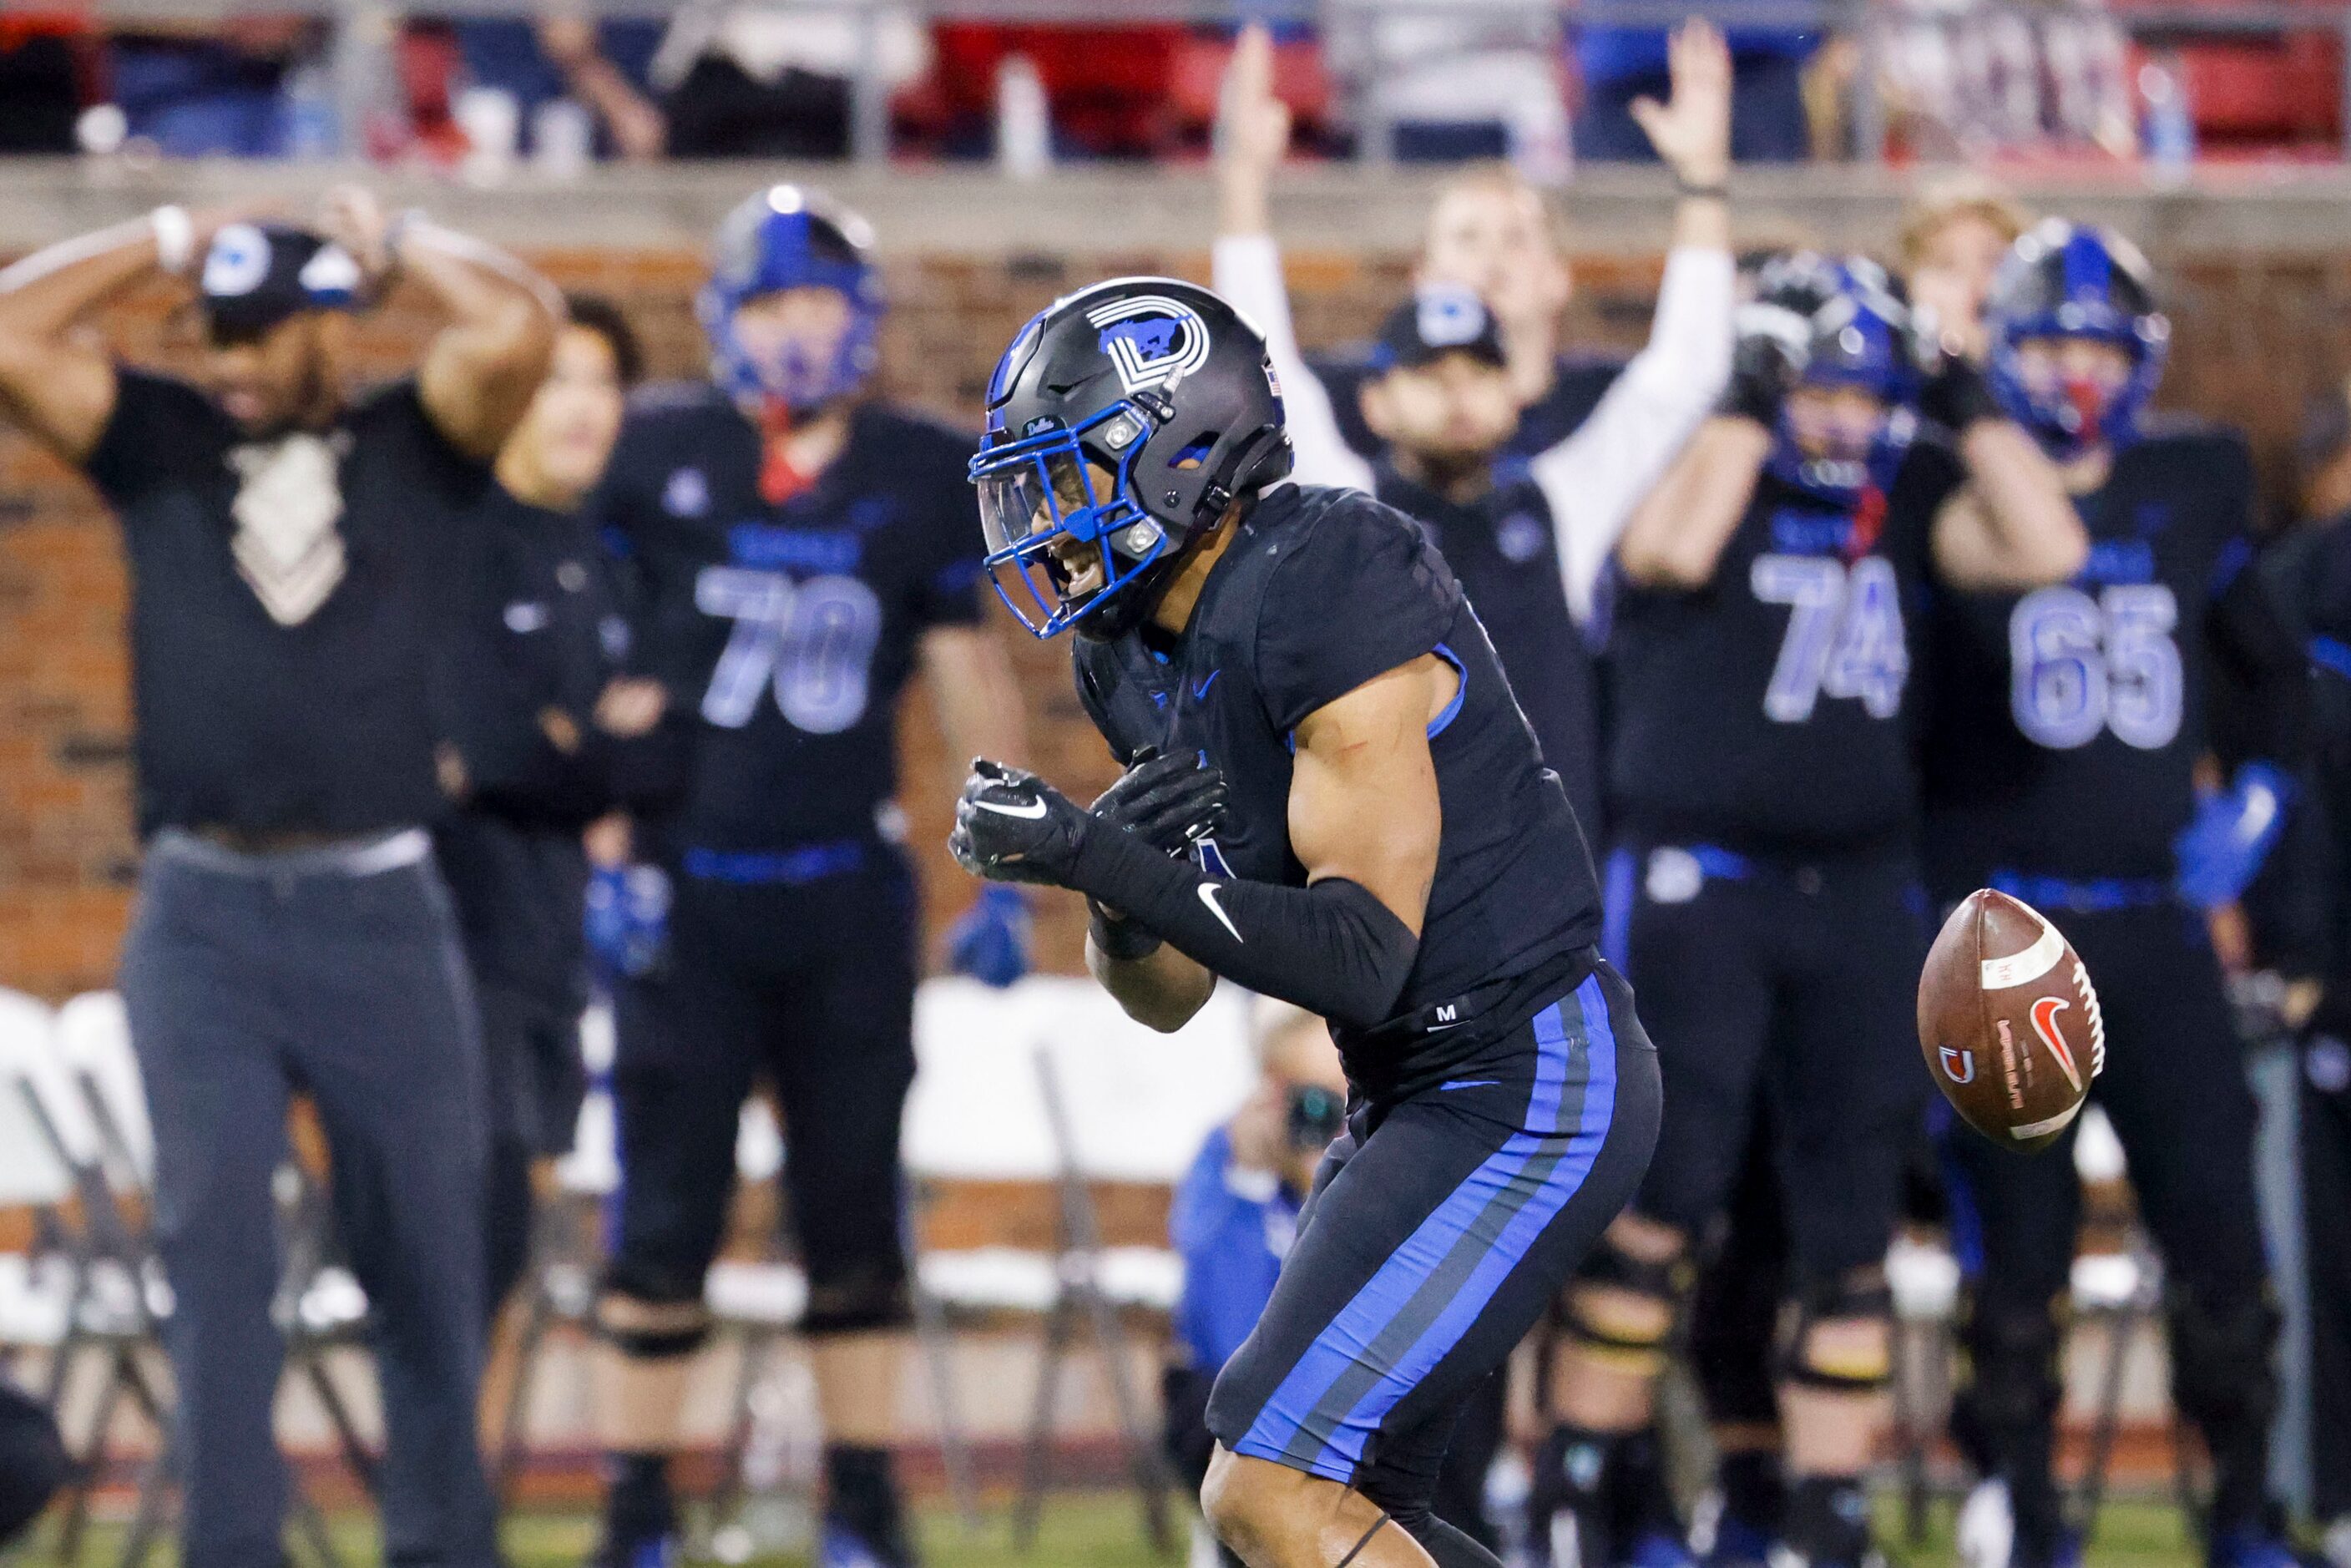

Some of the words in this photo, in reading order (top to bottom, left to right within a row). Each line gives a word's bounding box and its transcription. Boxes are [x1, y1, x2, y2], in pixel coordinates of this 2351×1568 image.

[1028, 417, 1054, 436] Dallas
[695, 566, 882, 735] 70
[1751, 554, 1910, 723] 74
[2010, 584, 2184, 750] 65
[1436, 1004, 1456, 1022] M
